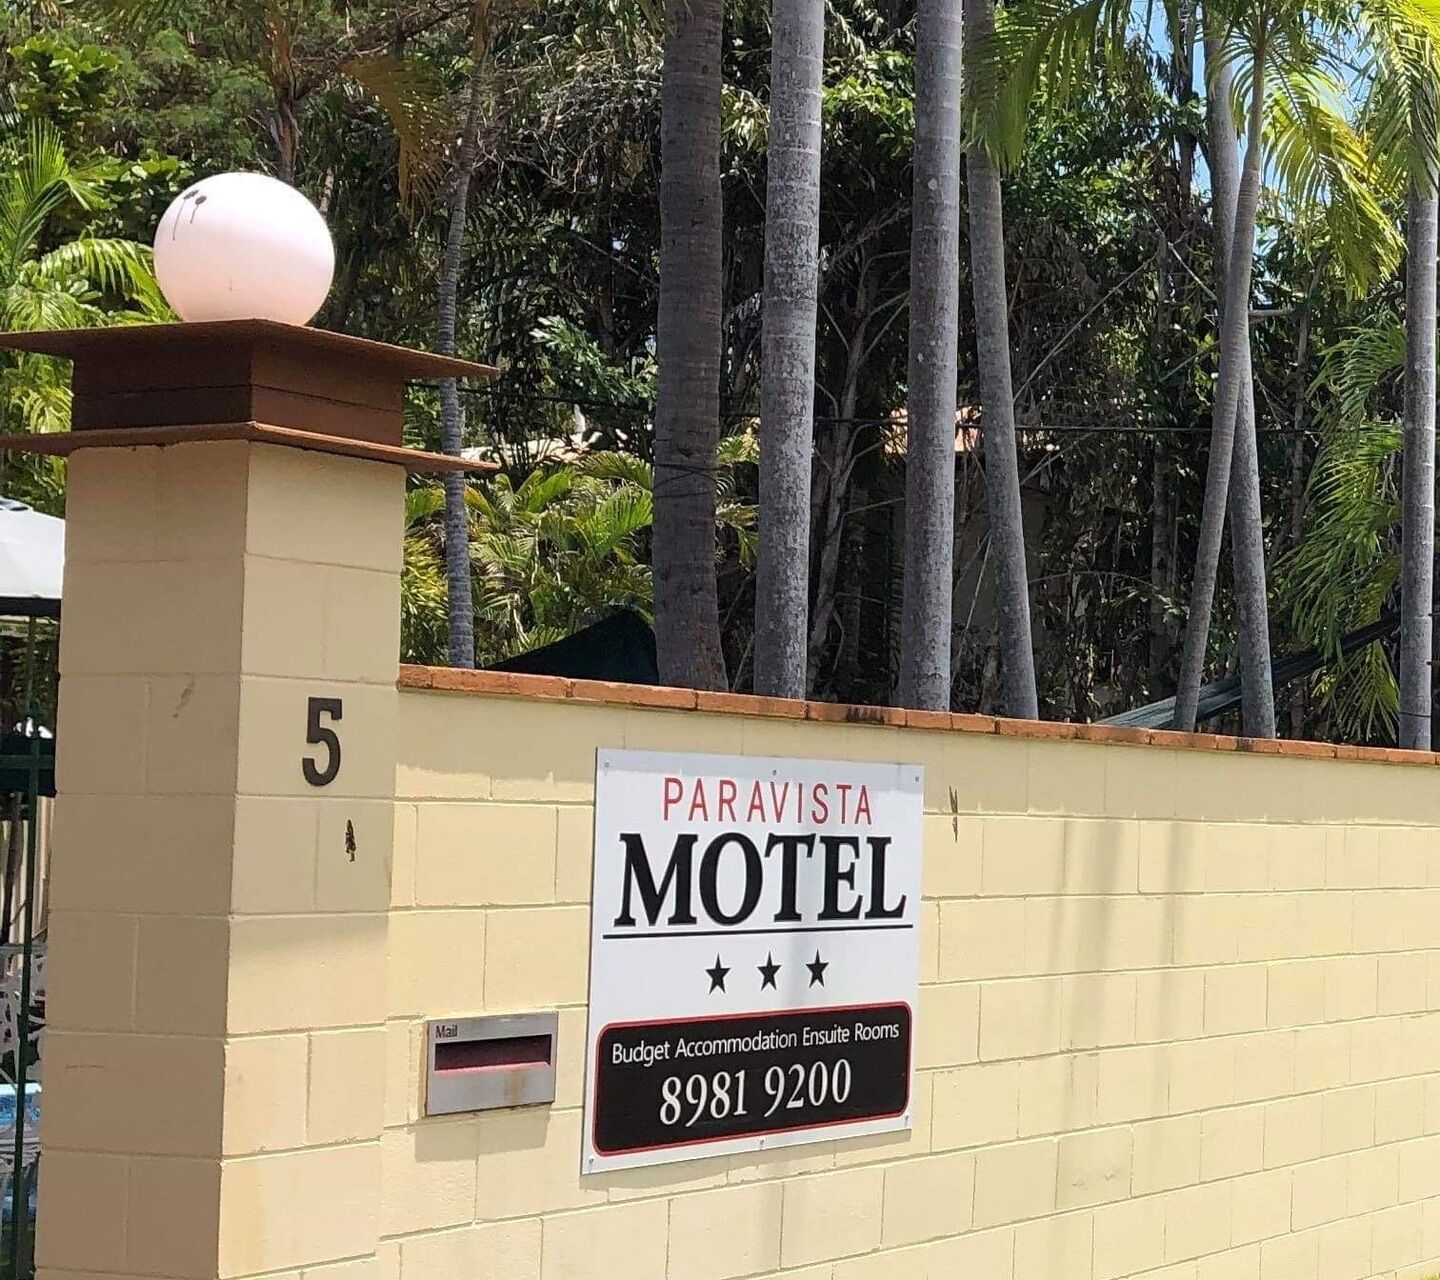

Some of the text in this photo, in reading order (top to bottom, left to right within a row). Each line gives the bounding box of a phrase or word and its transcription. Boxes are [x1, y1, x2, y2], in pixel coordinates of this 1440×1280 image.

[301, 696, 343, 787] 5
[662, 776, 872, 825] PARAVISTA
[613, 831, 907, 928] MOTEL
[435, 1024, 458, 1039] Mail
[612, 1022, 900, 1068] Budget Accommodation Ensuite Rooms
[659, 1058, 851, 1128] 8981 9200
